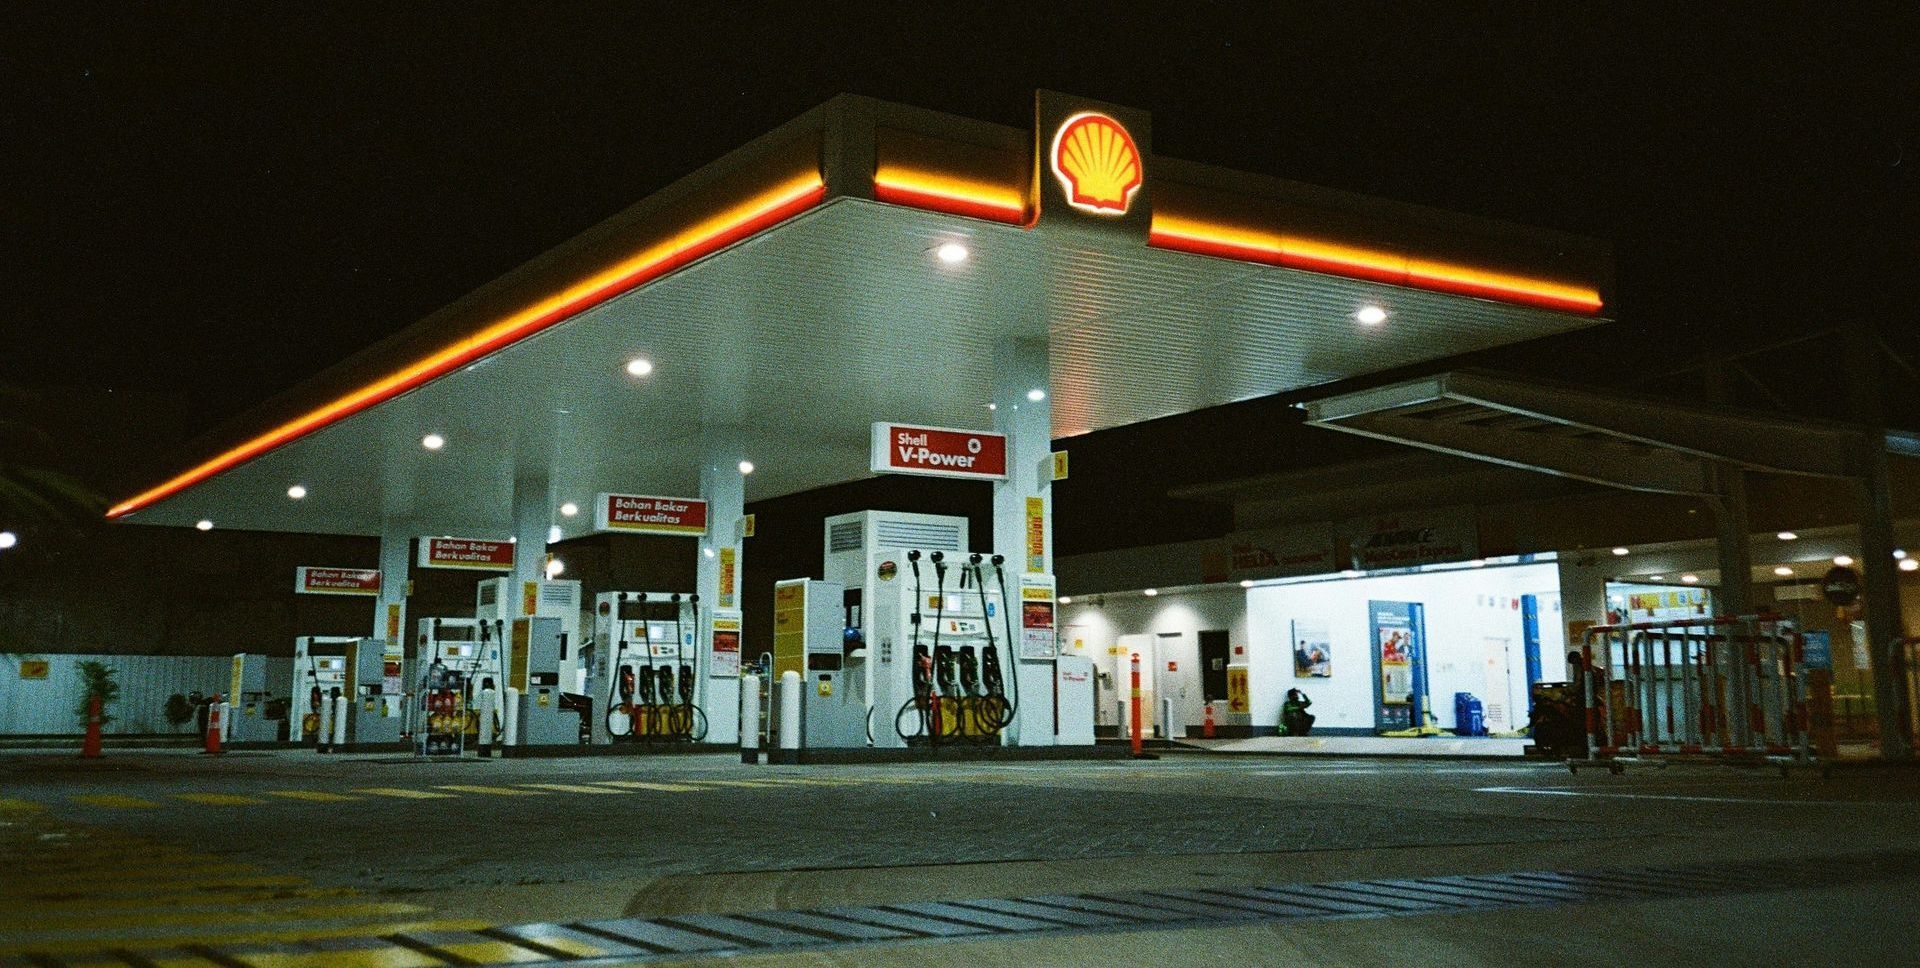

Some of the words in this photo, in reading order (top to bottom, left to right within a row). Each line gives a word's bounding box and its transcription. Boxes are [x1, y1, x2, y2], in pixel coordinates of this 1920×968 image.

[898, 432, 927, 446] Shell
[898, 446, 975, 468] V-Power
[615, 498, 652, 510] Bahan
[654, 501, 689, 512] Bakar
[614, 511, 681, 524] Berkualitas
[435, 540, 467, 551] Bahan
[469, 541, 499, 552] Bakar
[434, 550, 492, 562] Berkualitas
[310, 570, 339, 580] Bahan
[310, 579, 360, 589] Berkualitas
